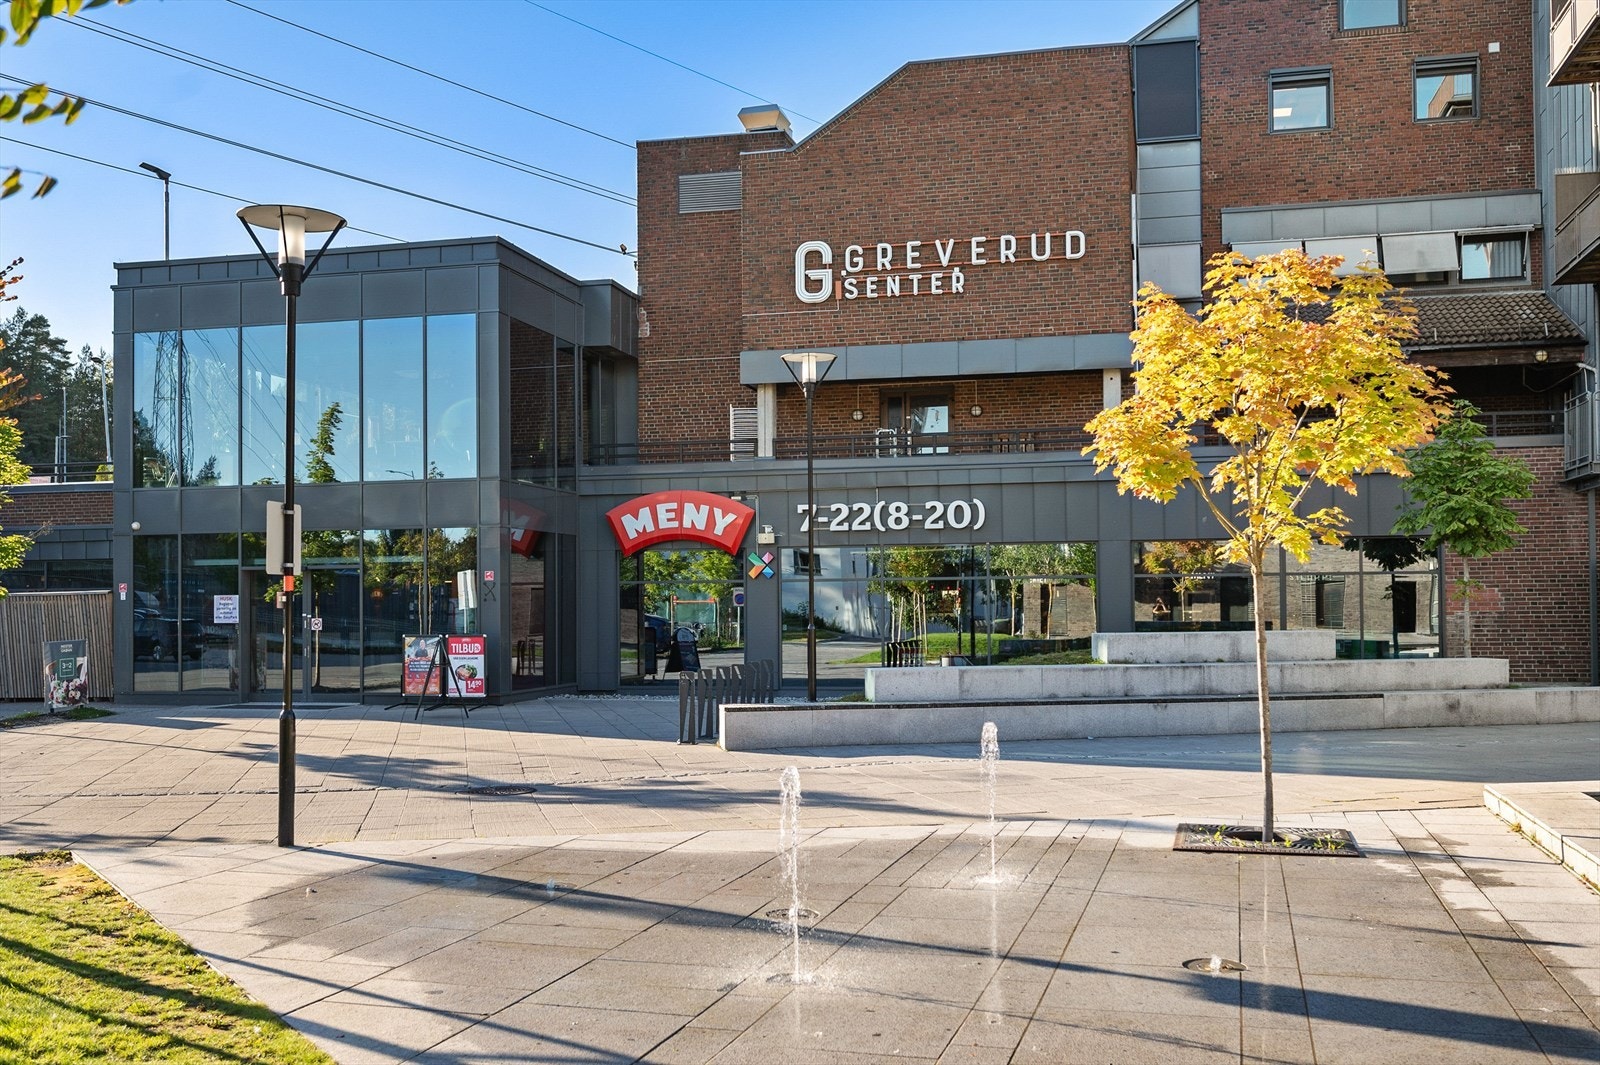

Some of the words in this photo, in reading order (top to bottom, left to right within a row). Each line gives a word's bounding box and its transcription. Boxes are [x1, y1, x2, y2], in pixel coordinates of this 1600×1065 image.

[844, 230, 1086, 273] GREVERUD
[795, 240, 833, 304] G
[844, 271, 965, 300] SENTER
[620, 502, 738, 540] MENY
[797, 498, 986, 532] 7-22(8-20)
[451, 644, 482, 654] TILBUD
